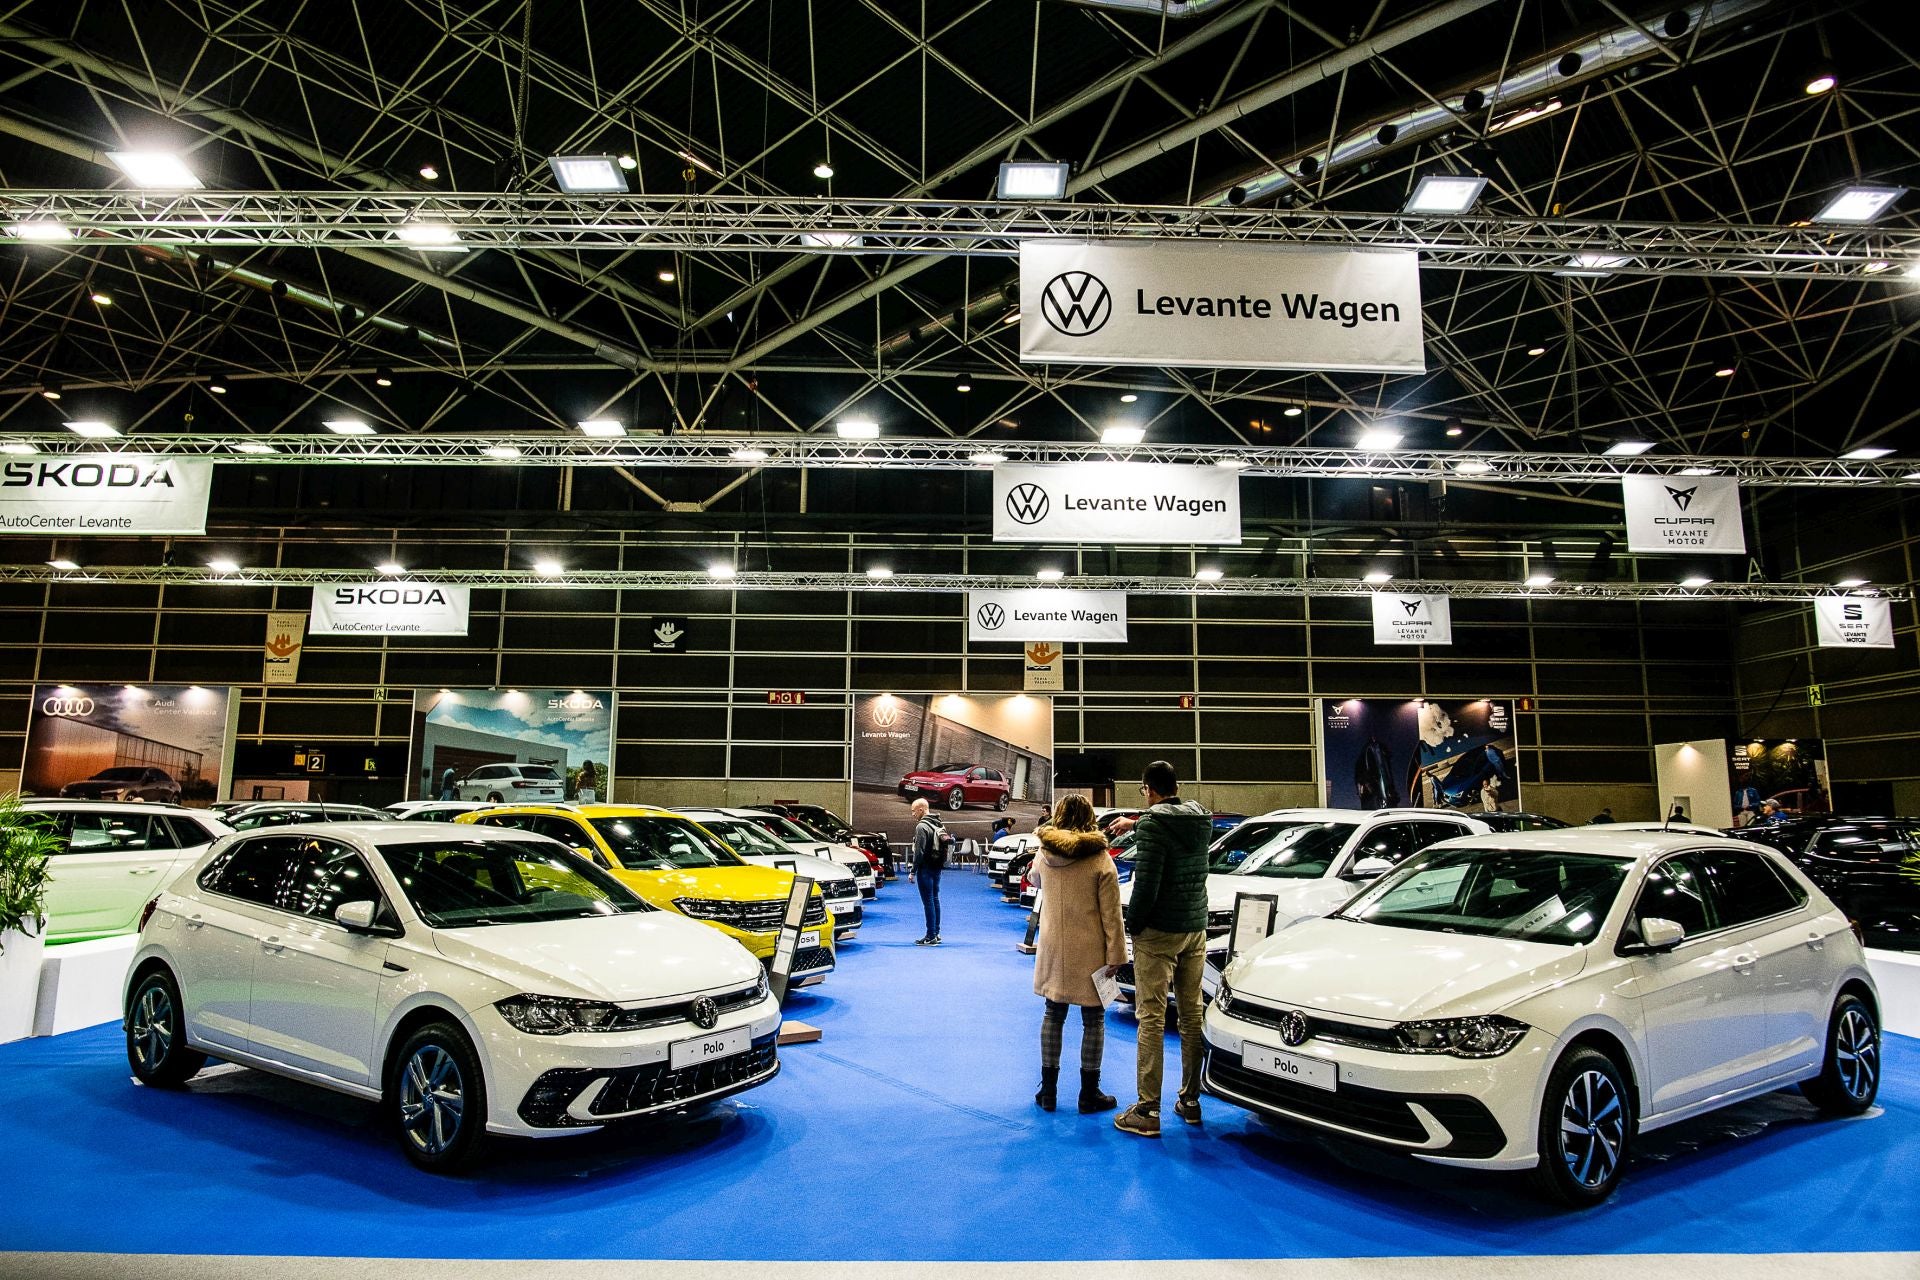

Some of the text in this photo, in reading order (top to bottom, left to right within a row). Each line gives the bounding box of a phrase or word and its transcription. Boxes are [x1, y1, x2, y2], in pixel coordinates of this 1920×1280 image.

[1137, 288, 1401, 328] Levante Wagen
[1064, 493, 1227, 517] Levante Wagen
[79, 515, 132, 528] Levante
[1654, 517, 1715, 525] CUPRA
[1663, 529, 1709, 538] LEVANTE
[1014, 609, 1118, 625] Levante Wagen
[332, 622, 421, 632] AutoCenter Levante
[861, 731, 911, 740] Levante Wagen
[311, 757, 321, 769] 2
[703, 1041, 725, 1055] Polo
[1274, 1057, 1299, 1075] Polo
